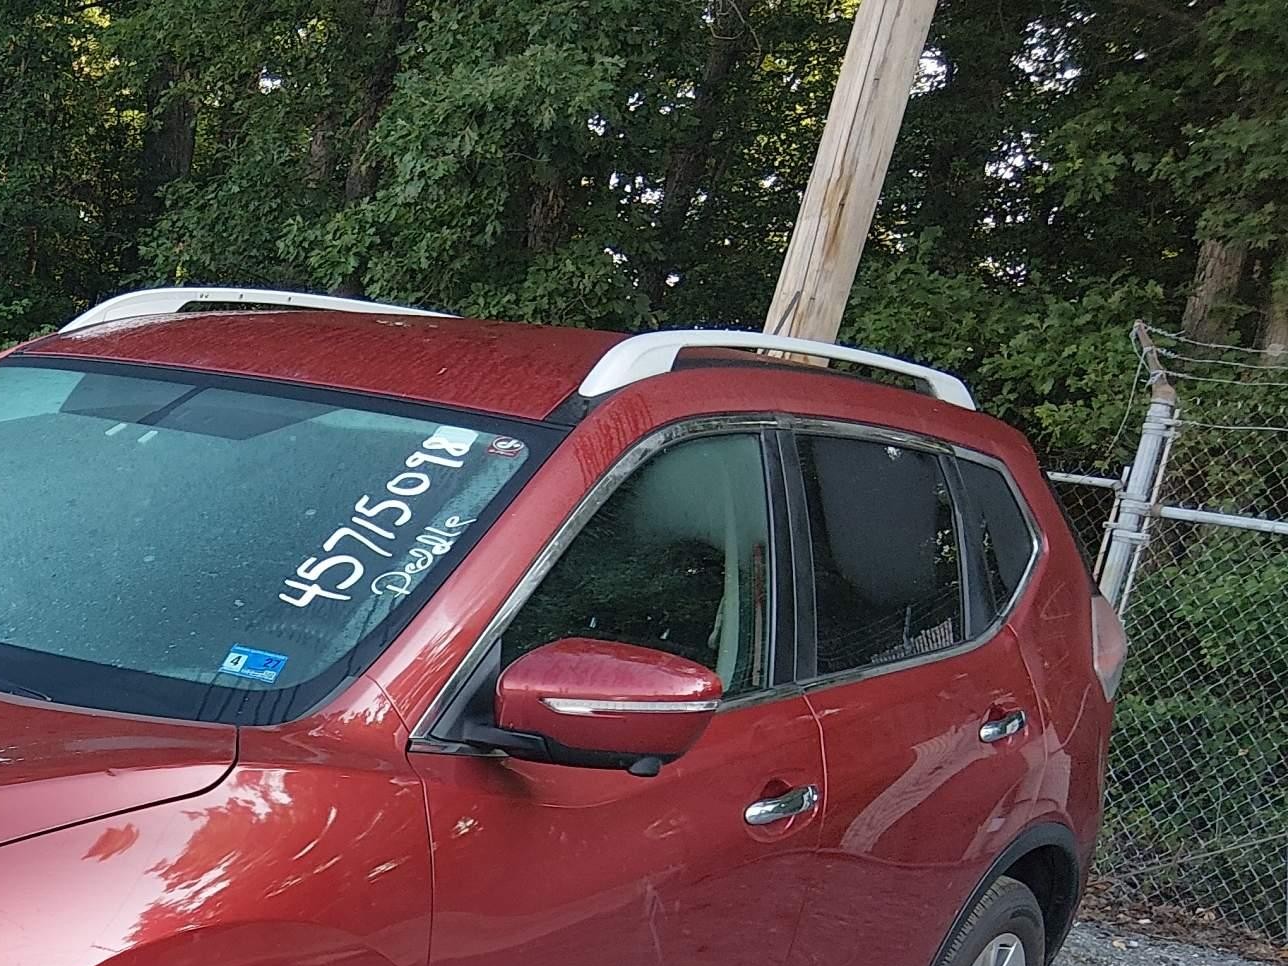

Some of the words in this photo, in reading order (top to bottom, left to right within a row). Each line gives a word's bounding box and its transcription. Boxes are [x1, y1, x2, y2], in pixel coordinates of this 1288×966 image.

[278, 435, 472, 608] 45715098
[230, 655, 243, 667] 4
[263, 657, 282, 669] 27
